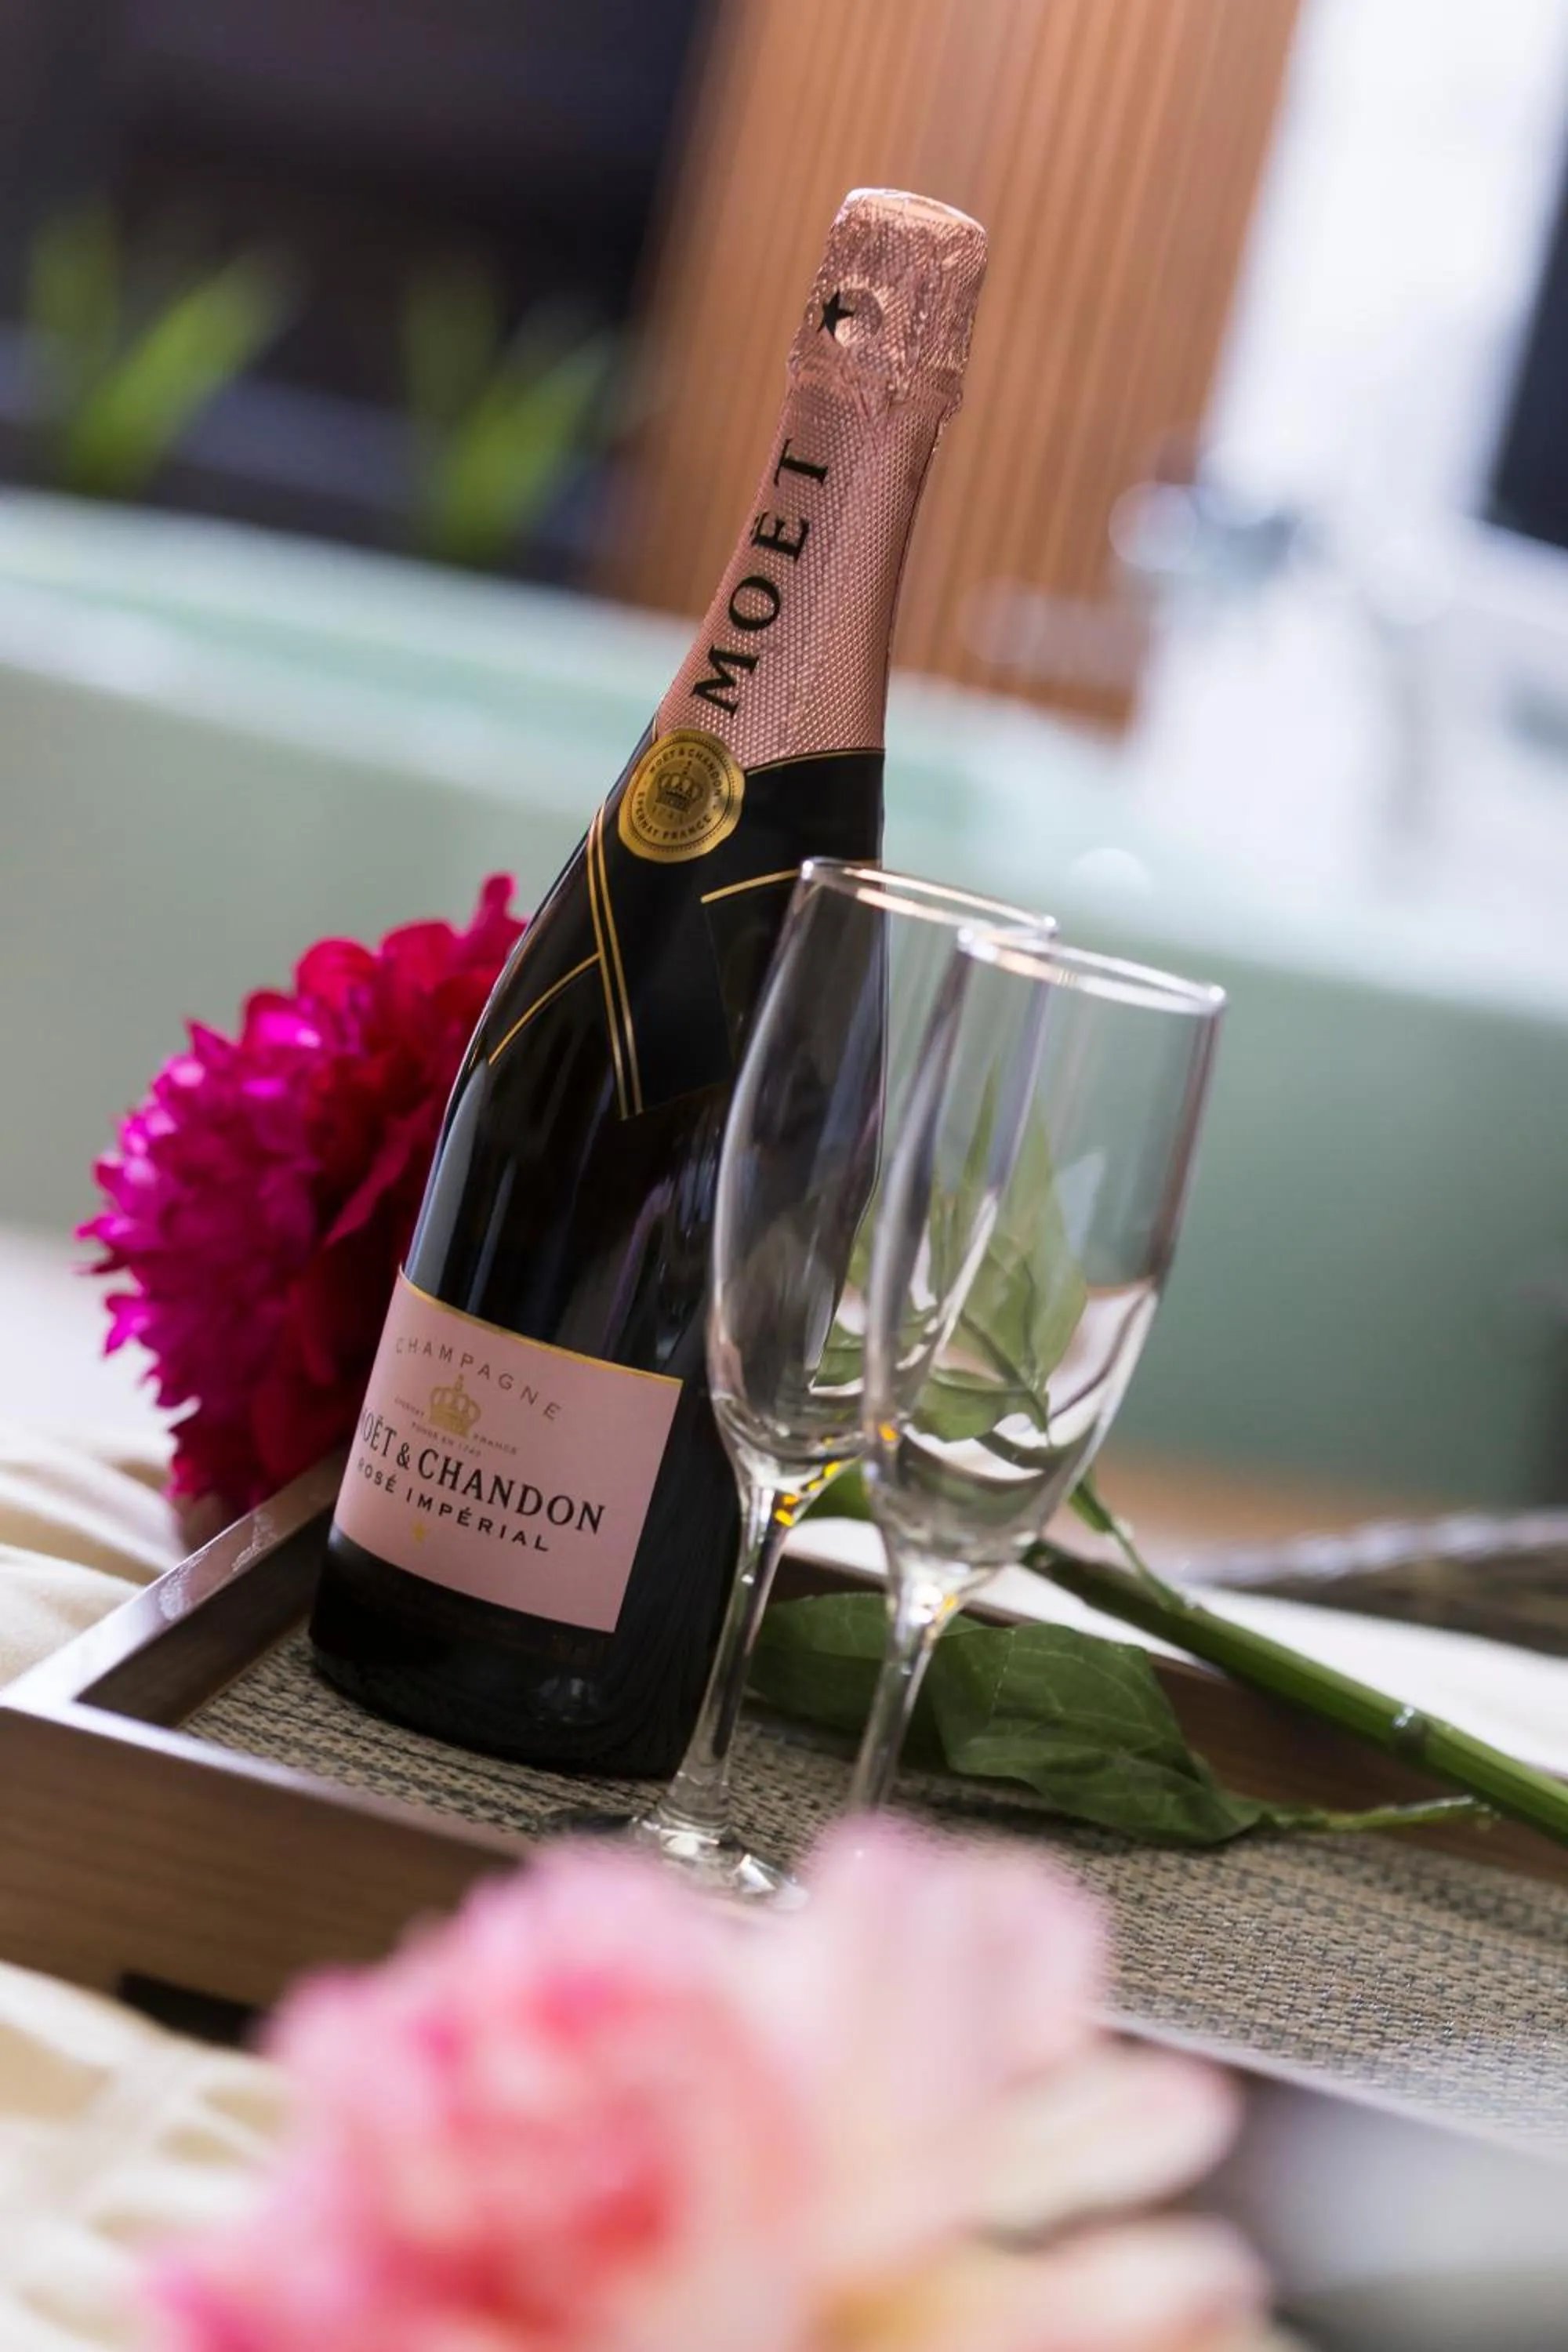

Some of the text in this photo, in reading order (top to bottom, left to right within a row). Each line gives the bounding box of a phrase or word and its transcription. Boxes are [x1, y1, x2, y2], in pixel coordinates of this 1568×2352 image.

[662, 814, 712, 840] FRANCE
[395, 1336, 563, 1421] CHAMPAGNE
[357, 1457, 550, 1553] ROSÉ IMPÉRIAL
[396, 1442, 411, 1471] &
[418, 1447, 606, 1535] CHANDON
